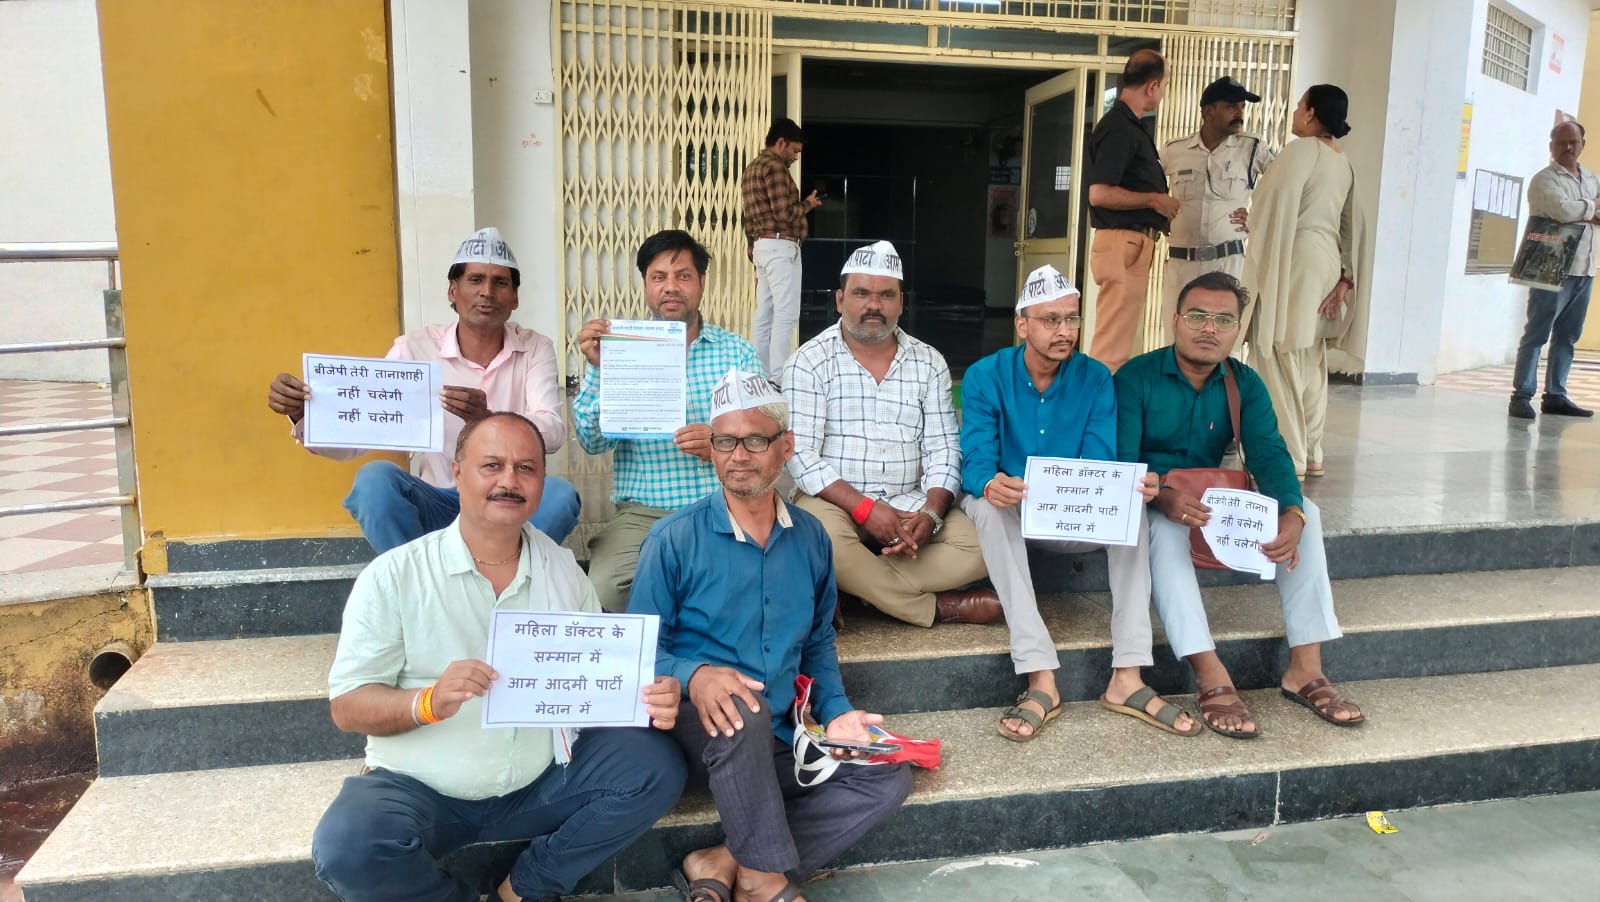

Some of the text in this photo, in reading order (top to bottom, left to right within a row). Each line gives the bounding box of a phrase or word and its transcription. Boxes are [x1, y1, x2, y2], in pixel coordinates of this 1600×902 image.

[314, 362, 424, 382] बीजेपी तेरी तानाशाही
[337, 385, 403, 401] नहीं चलेगी
[338, 408, 405, 424] नहीं चलेगी
[1043, 465, 1122, 479] महिला डॉक्टर के
[1056, 485, 1104, 496] सम्मान में
[1037, 502, 1119, 516] आम आदमी पार्टी
[1086, 521, 1096, 533] में
[1236, 517, 1264, 532] चलेगी
[515, 620, 626, 639] महिला डॉक्टर के
[534, 648, 603, 664] सम्मान में
[507, 674, 623, 692] आम आदमी पार्टी
[535, 700, 592, 716] मेदान में
